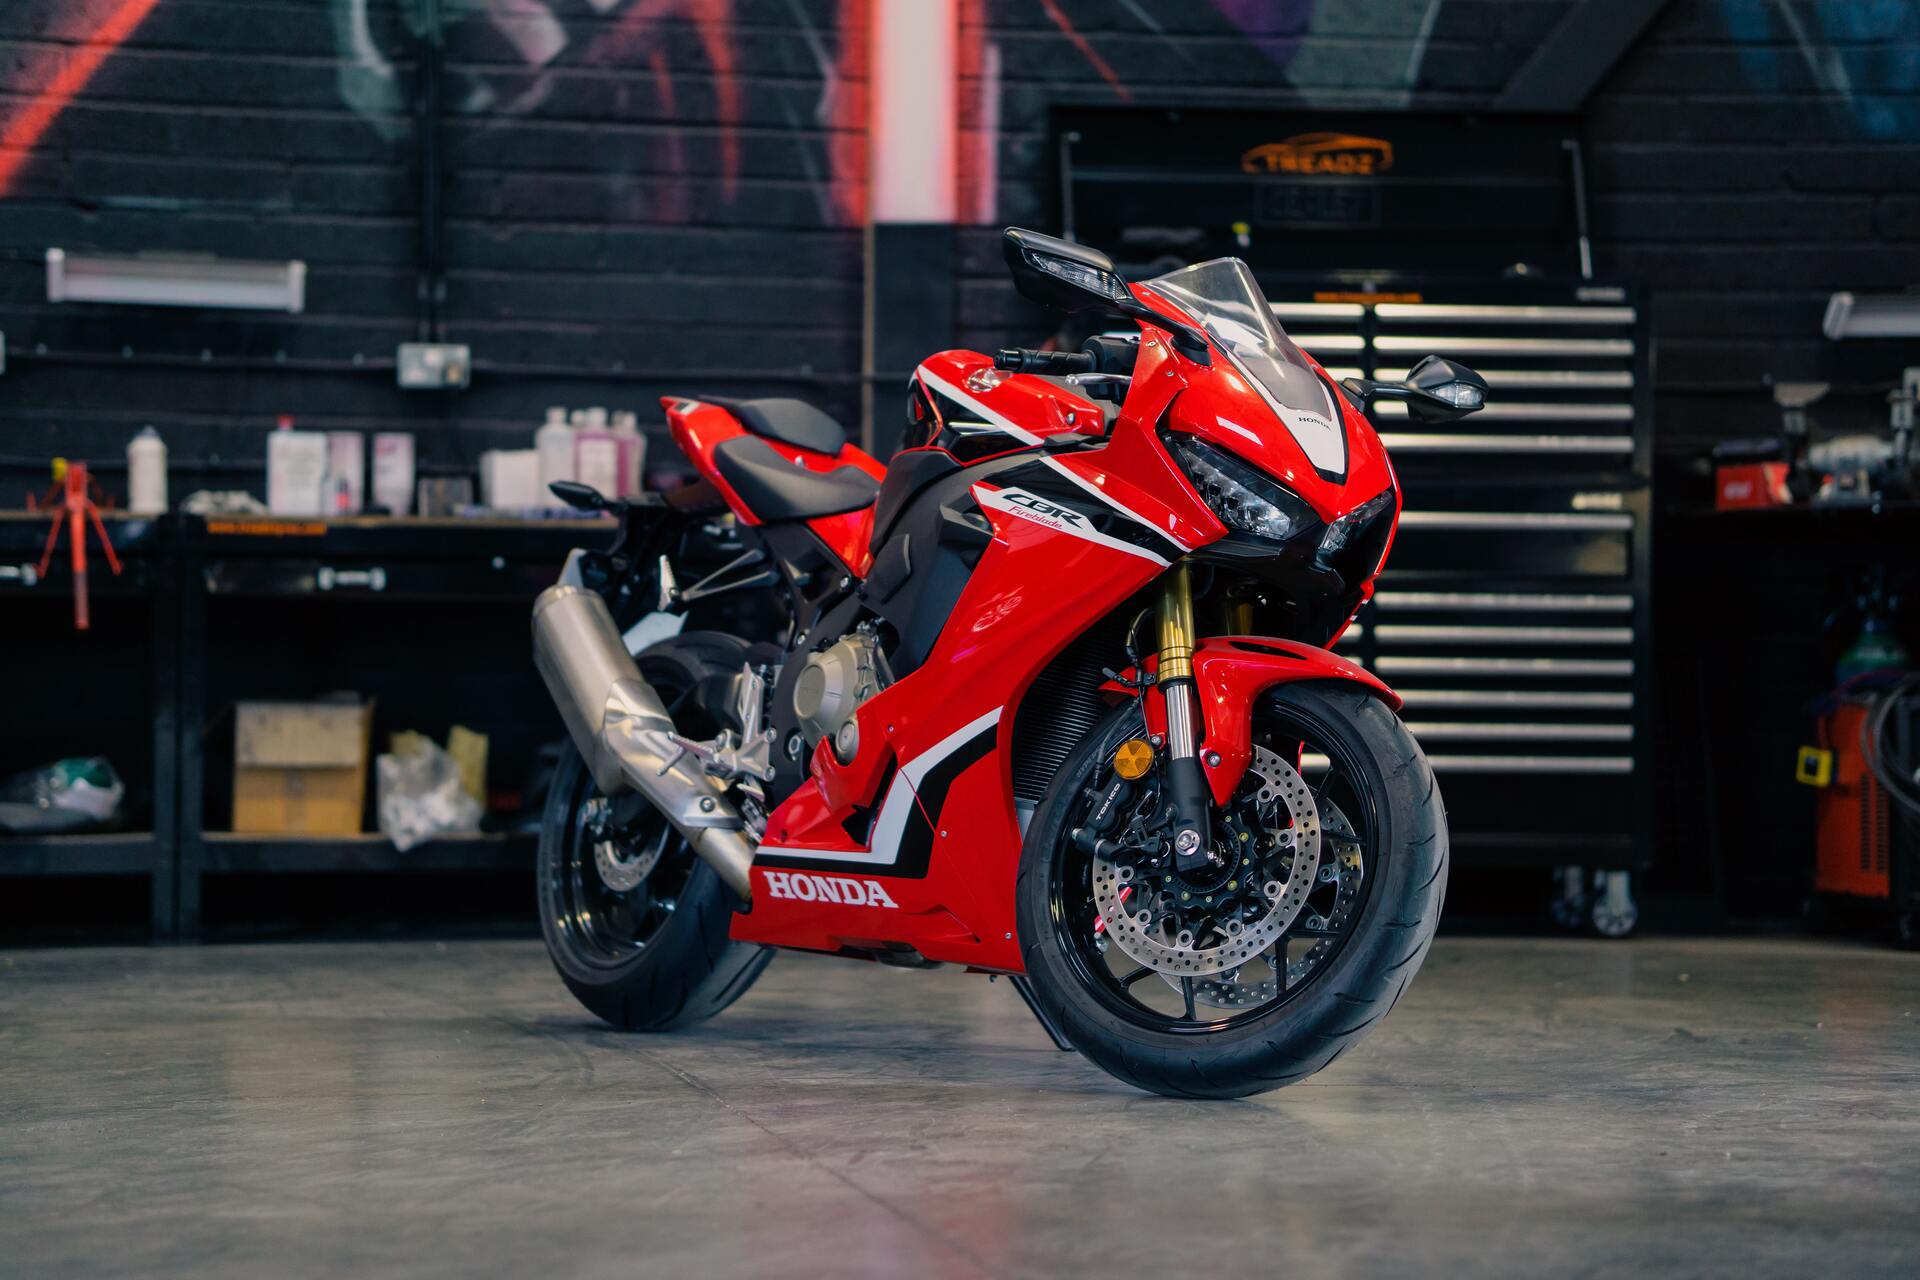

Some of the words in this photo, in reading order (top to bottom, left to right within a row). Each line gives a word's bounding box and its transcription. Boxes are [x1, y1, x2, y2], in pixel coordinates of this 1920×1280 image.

[1298, 417, 1331, 431] HONDA
[1002, 493, 1083, 529] CBR
[1008, 505, 1063, 529] Fireblade
[1096, 783, 1121, 821] TOKICO
[762, 870, 900, 909] HONDA
